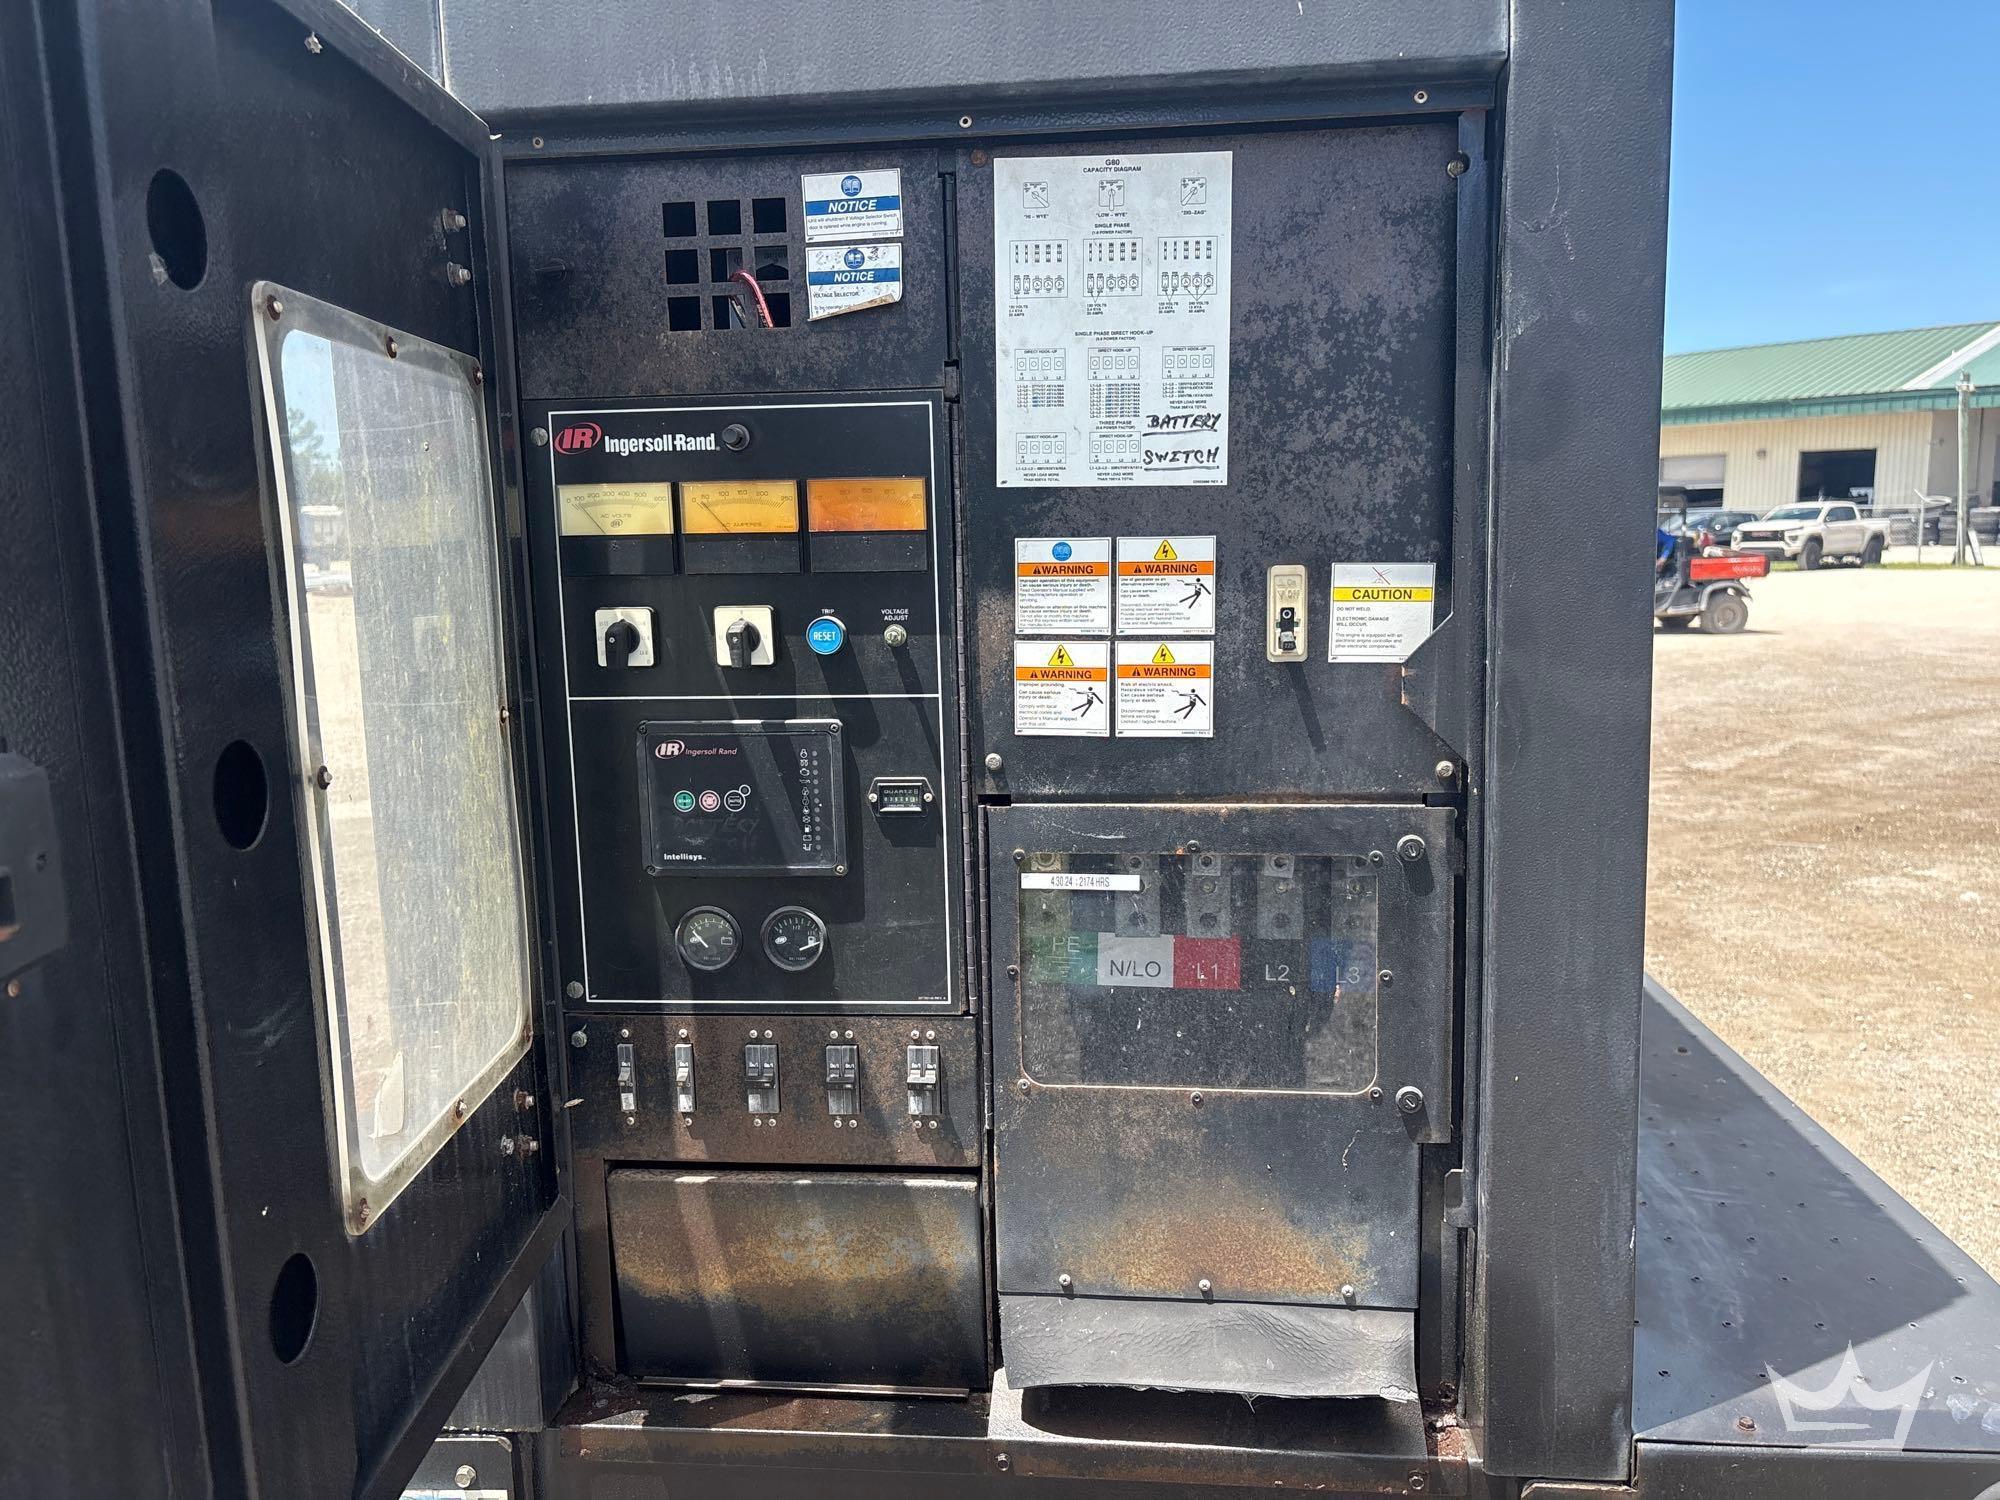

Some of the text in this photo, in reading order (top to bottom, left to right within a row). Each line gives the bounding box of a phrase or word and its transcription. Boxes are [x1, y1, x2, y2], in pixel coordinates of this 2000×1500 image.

[828, 200, 877, 213] NOTICE
[834, 271, 875, 282] NOTICE
[1146, 413, 1221, 429] BATTERY
[1143, 446, 1219, 465] SWITCH
[1042, 565, 1094, 574] WARNING
[1145, 564, 1198, 573] WARNING
[1352, 589, 1412, 600] CAUTION
[813, 631, 836, 642] RESET
[1040, 670, 1092, 678] WARNING
[1144, 668, 1196, 676] WARNING
[1079, 877, 1094, 886] 2174
[1096, 877, 1109, 887] HRS
[1052, 937, 1079, 952] PE
[1109, 959, 1360, 984] N/LO L1 L2 L3
